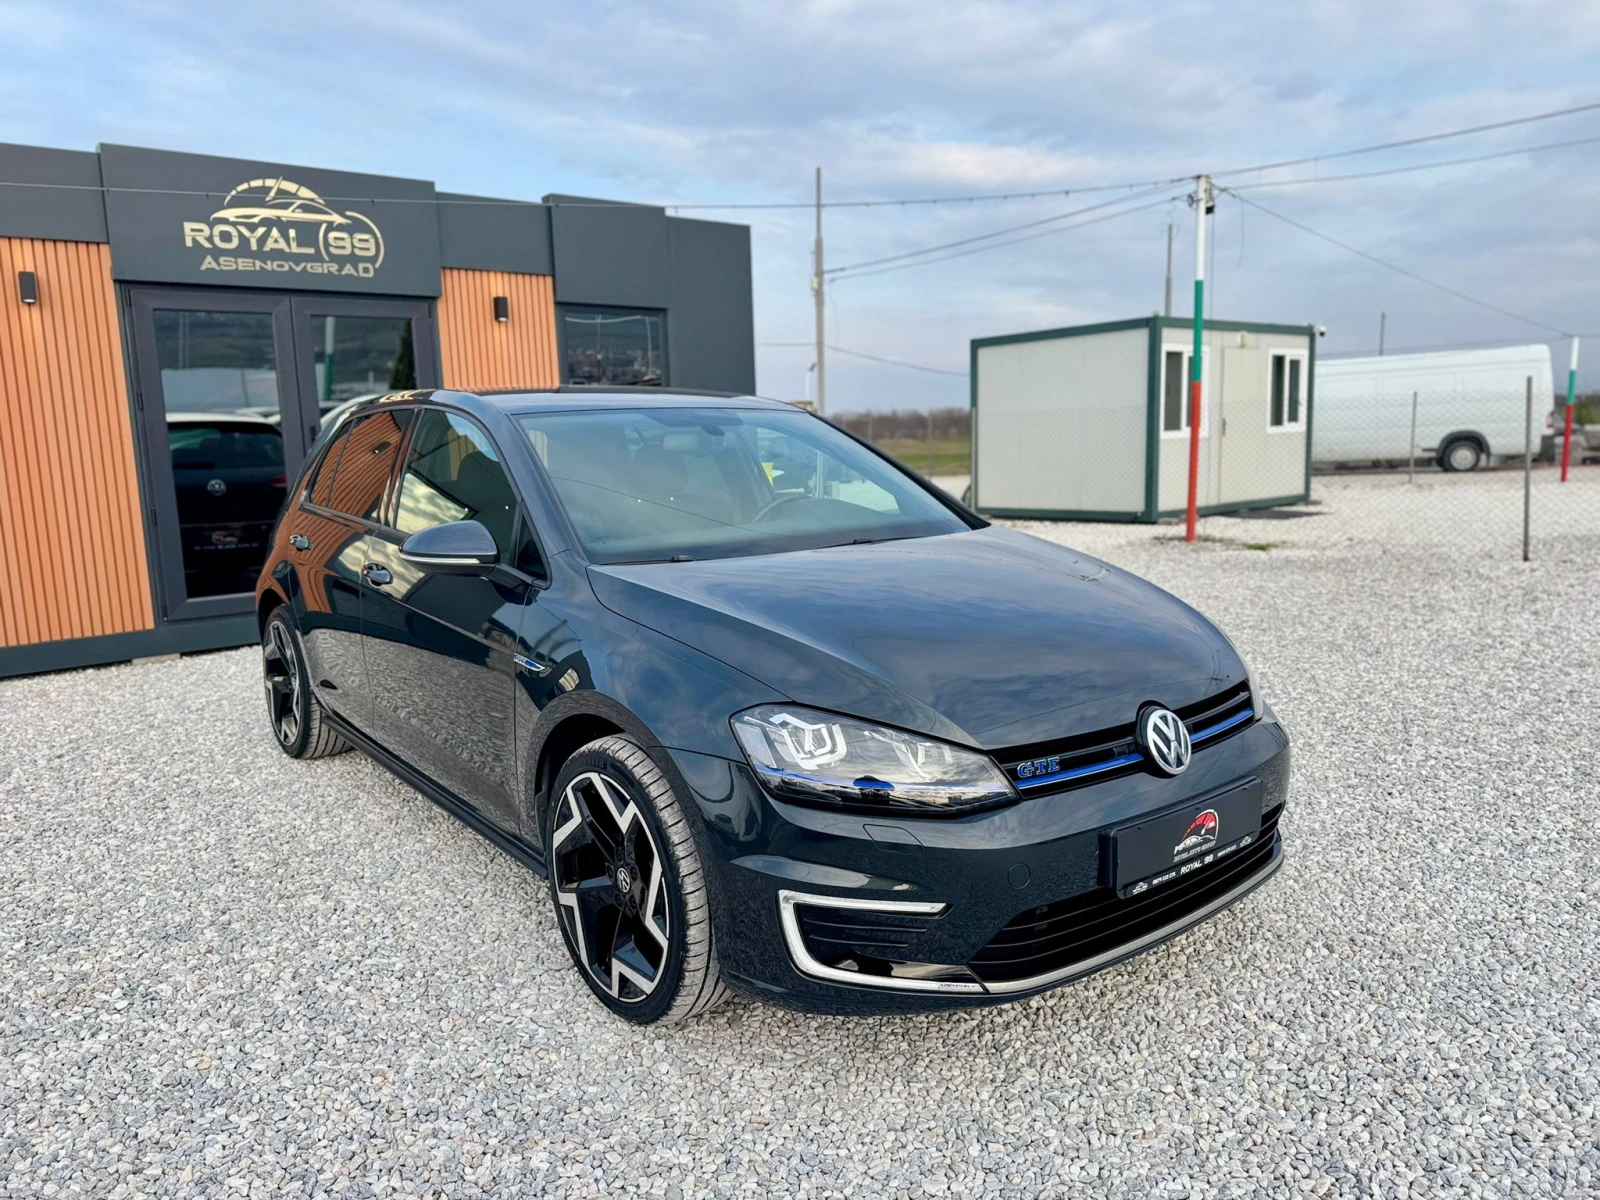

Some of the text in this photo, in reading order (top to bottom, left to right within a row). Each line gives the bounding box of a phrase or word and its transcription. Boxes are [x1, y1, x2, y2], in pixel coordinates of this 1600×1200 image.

[183, 221, 315, 254] ROYAL
[200, 254, 375, 278] ASENOVGRAD
[1017, 756, 1060, 778] GTE
[1180, 860, 1203, 875] ROYAL
[1203, 854, 1214, 865] 99
